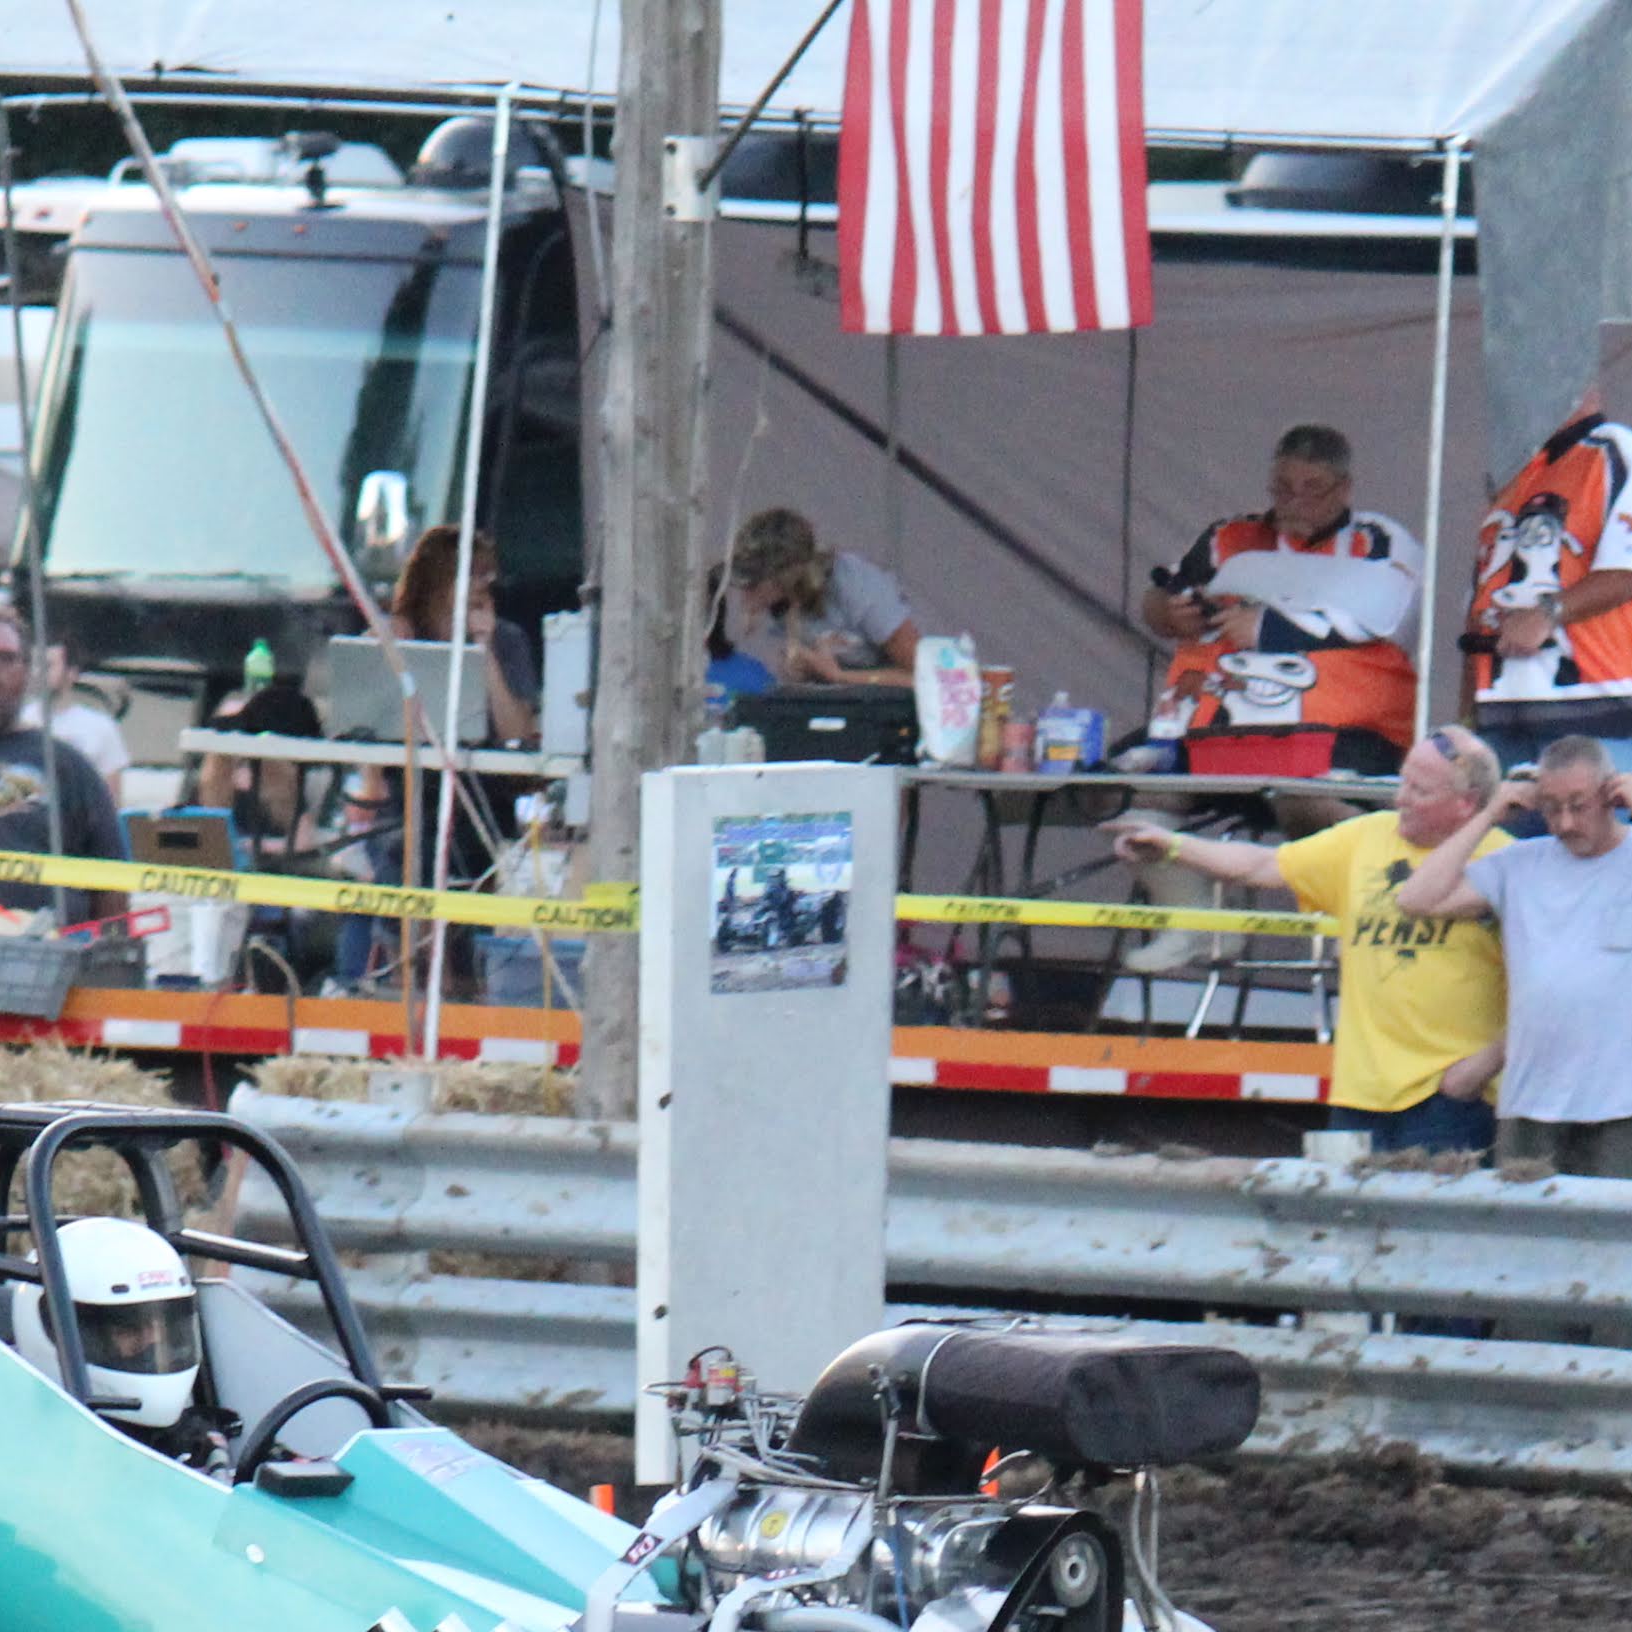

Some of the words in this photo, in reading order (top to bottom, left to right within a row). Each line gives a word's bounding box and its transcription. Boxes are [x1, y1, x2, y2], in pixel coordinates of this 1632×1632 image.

[139, 866, 240, 899] CAUTION
[334, 886, 437, 918] CAUTION
[532, 904, 634, 929] CAUTION
